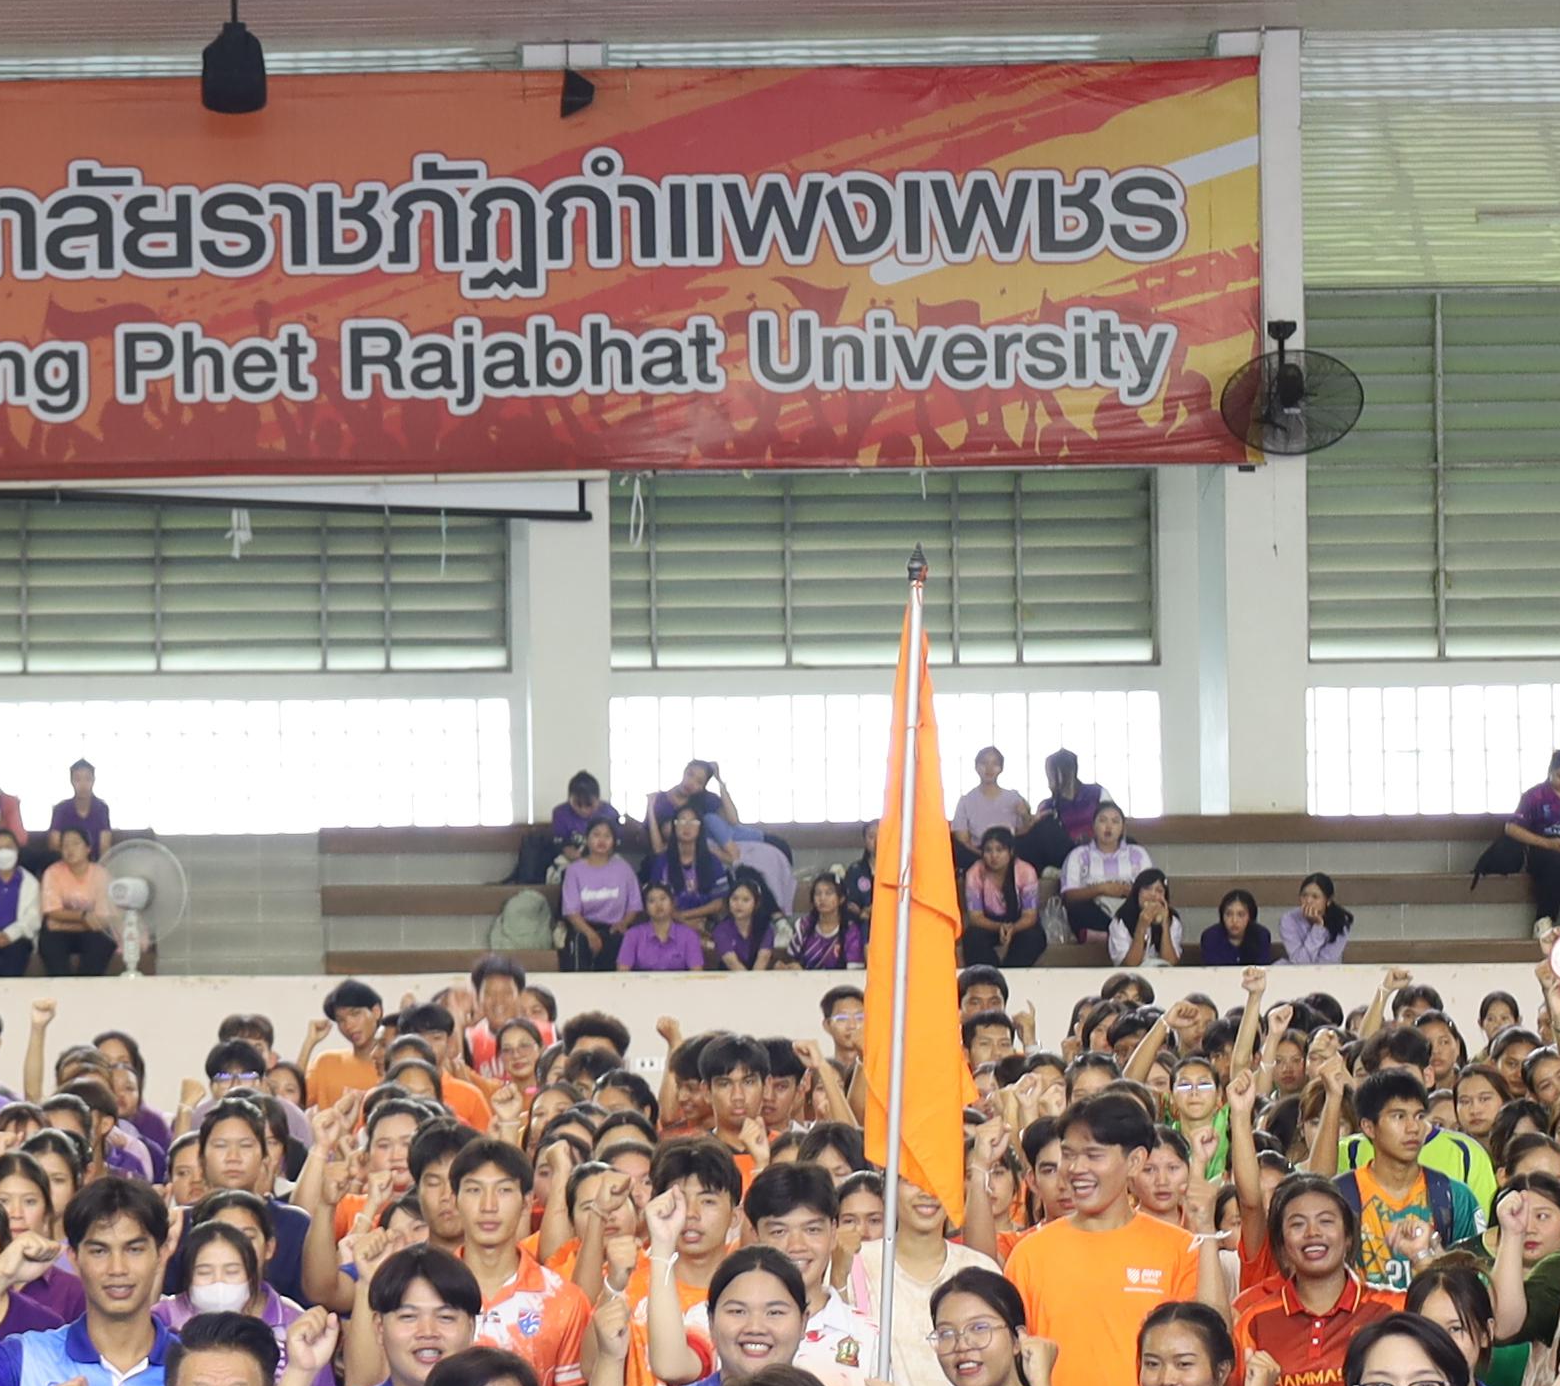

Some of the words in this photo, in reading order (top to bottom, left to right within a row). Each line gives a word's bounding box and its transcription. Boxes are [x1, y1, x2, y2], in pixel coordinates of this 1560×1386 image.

[124, 331, 310, 395] Phet
[354, 323, 716, 404] Rajabhat
[757, 318, 1165, 395] University
